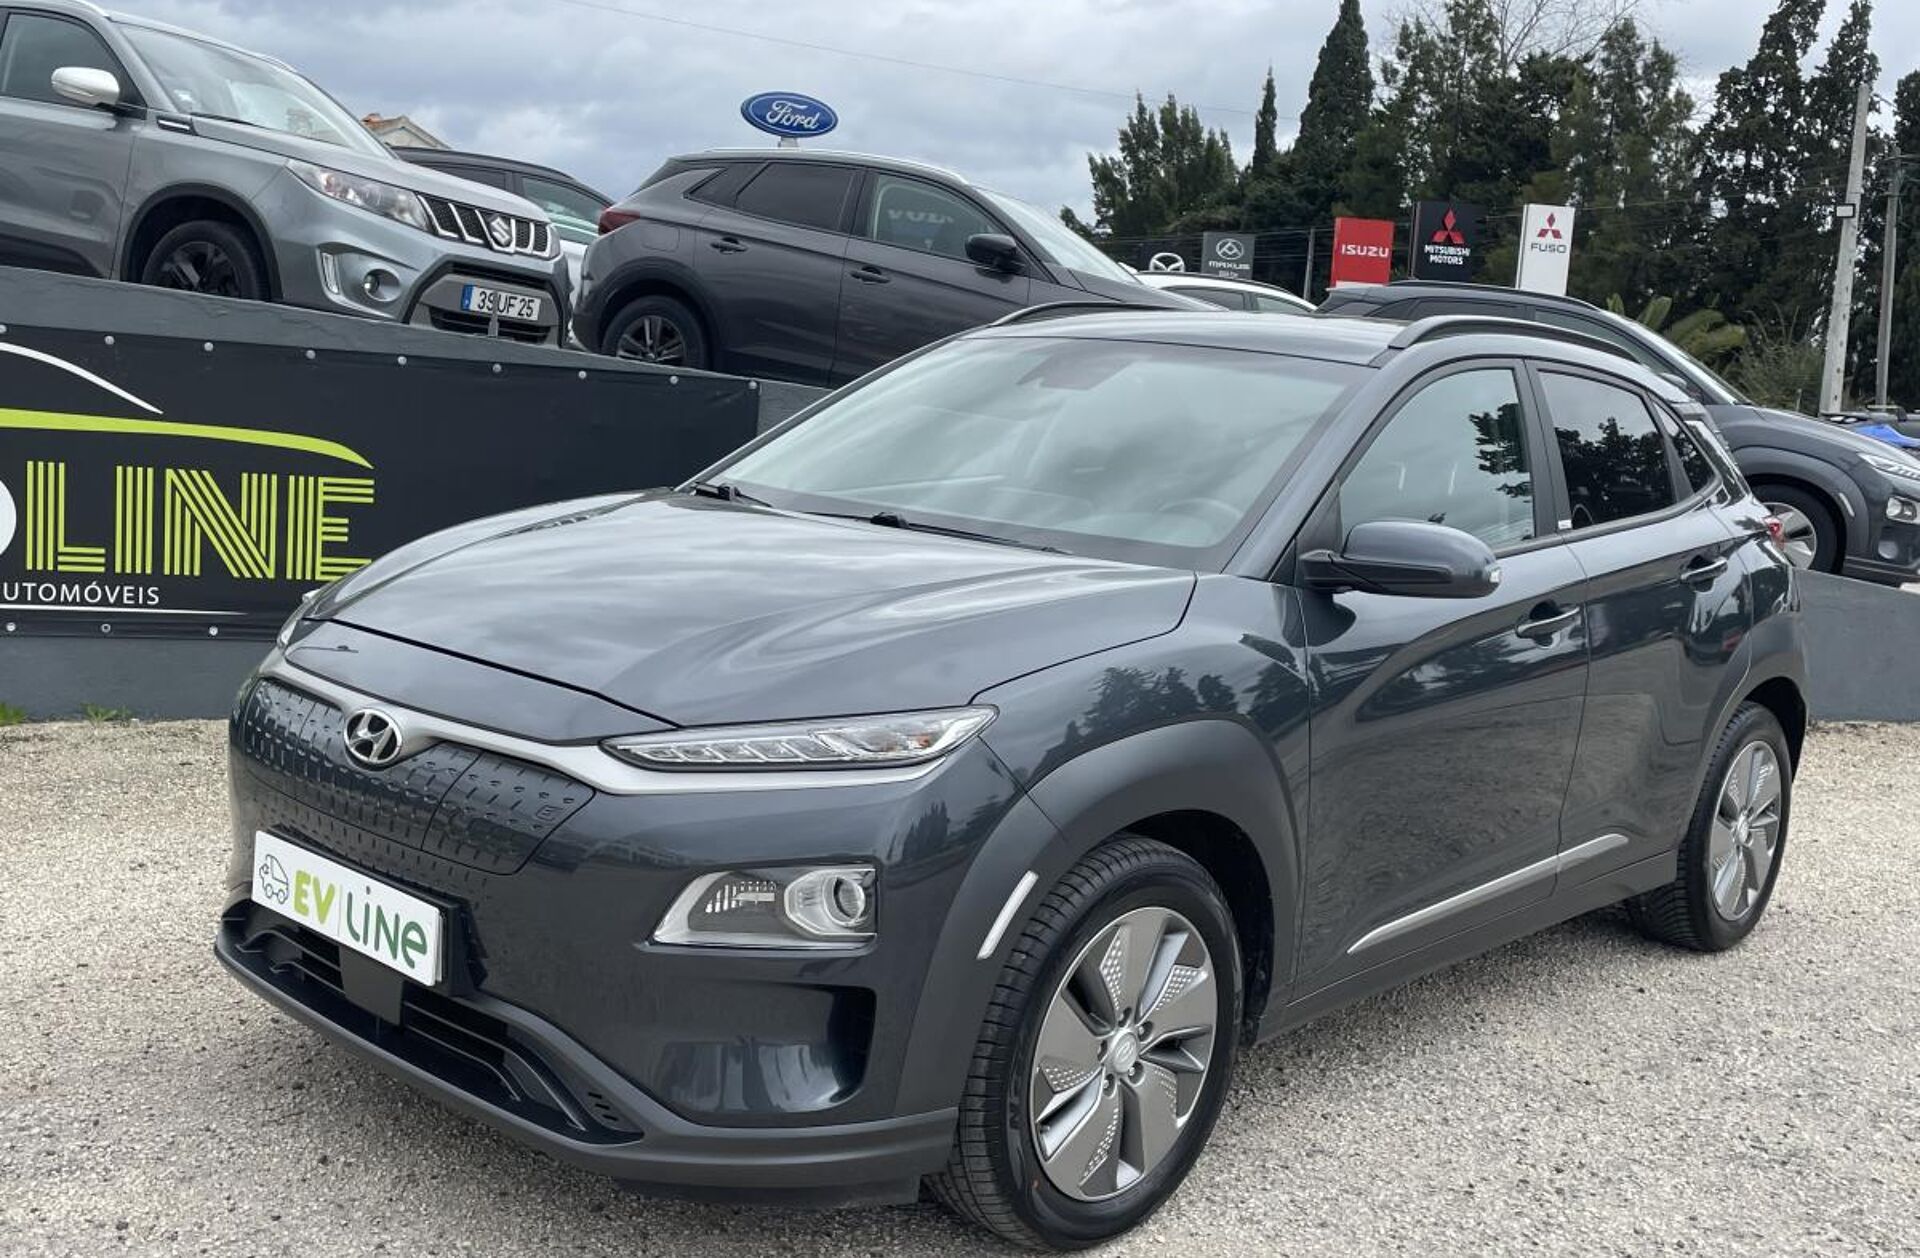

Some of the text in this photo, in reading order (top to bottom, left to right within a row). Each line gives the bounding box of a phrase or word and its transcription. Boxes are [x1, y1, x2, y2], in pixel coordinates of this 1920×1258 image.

[766, 101, 821, 129] Ford
[1341, 244, 1389, 258] ISUZU
[1424, 244, 1471, 257] MITSUBISHI
[1531, 243, 1567, 254] FUSO
[1429, 254, 1464, 265] MOTORS
[517, 298, 535, 318] 25
[0, 460, 375, 582] LINE
[293, 869, 336, 925] EV
